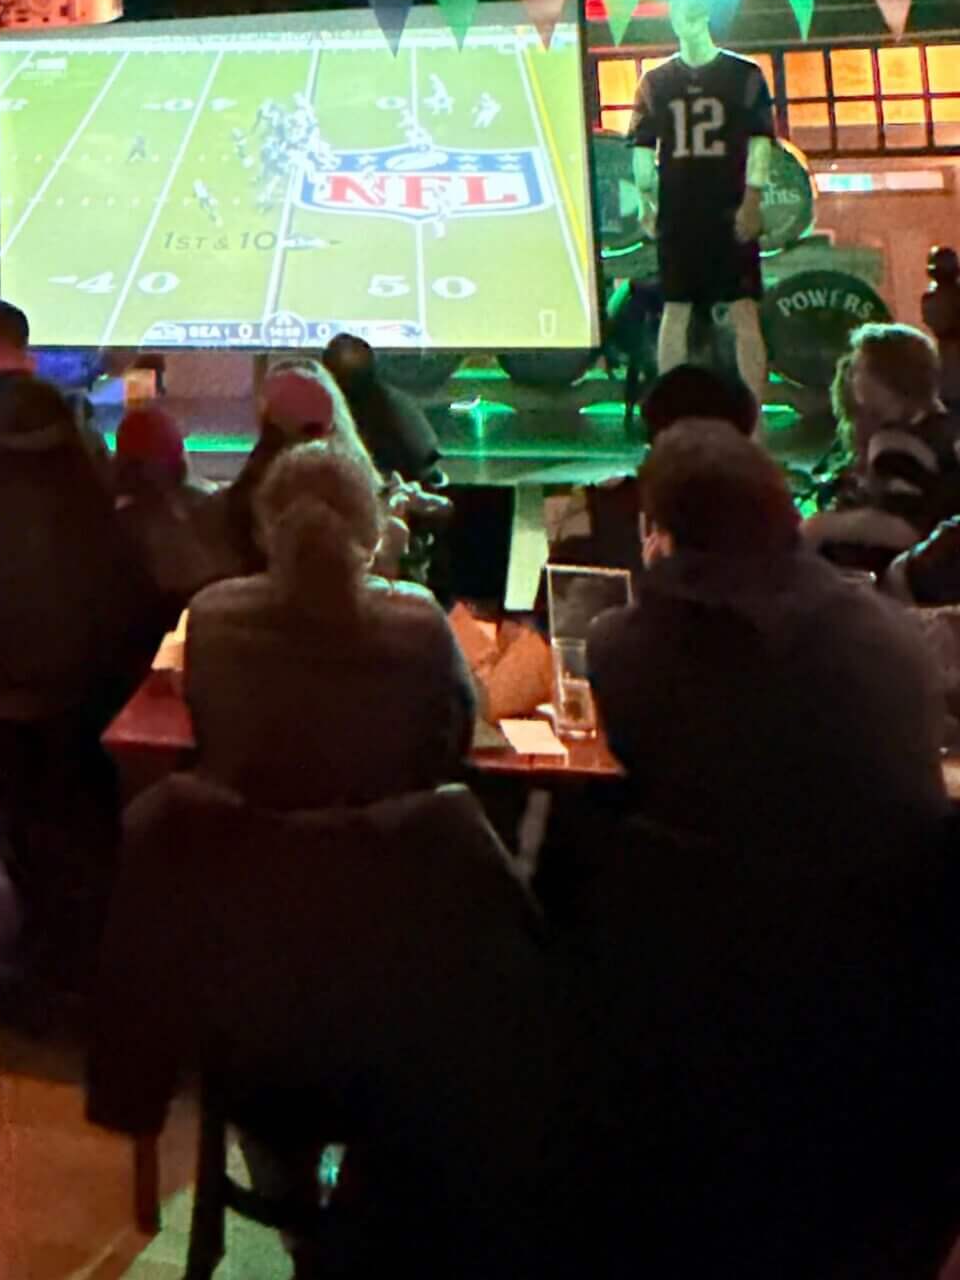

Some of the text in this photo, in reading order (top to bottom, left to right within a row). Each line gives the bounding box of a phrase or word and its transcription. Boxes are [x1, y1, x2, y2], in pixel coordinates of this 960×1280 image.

[668, 96, 727, 159] 12
[324, 175, 518, 209] NFL
[240, 231, 276, 250] 10
[777, 286, 874, 319] POWERS
[238, 324, 253, 339] 0
[316, 323, 331, 338] 0
